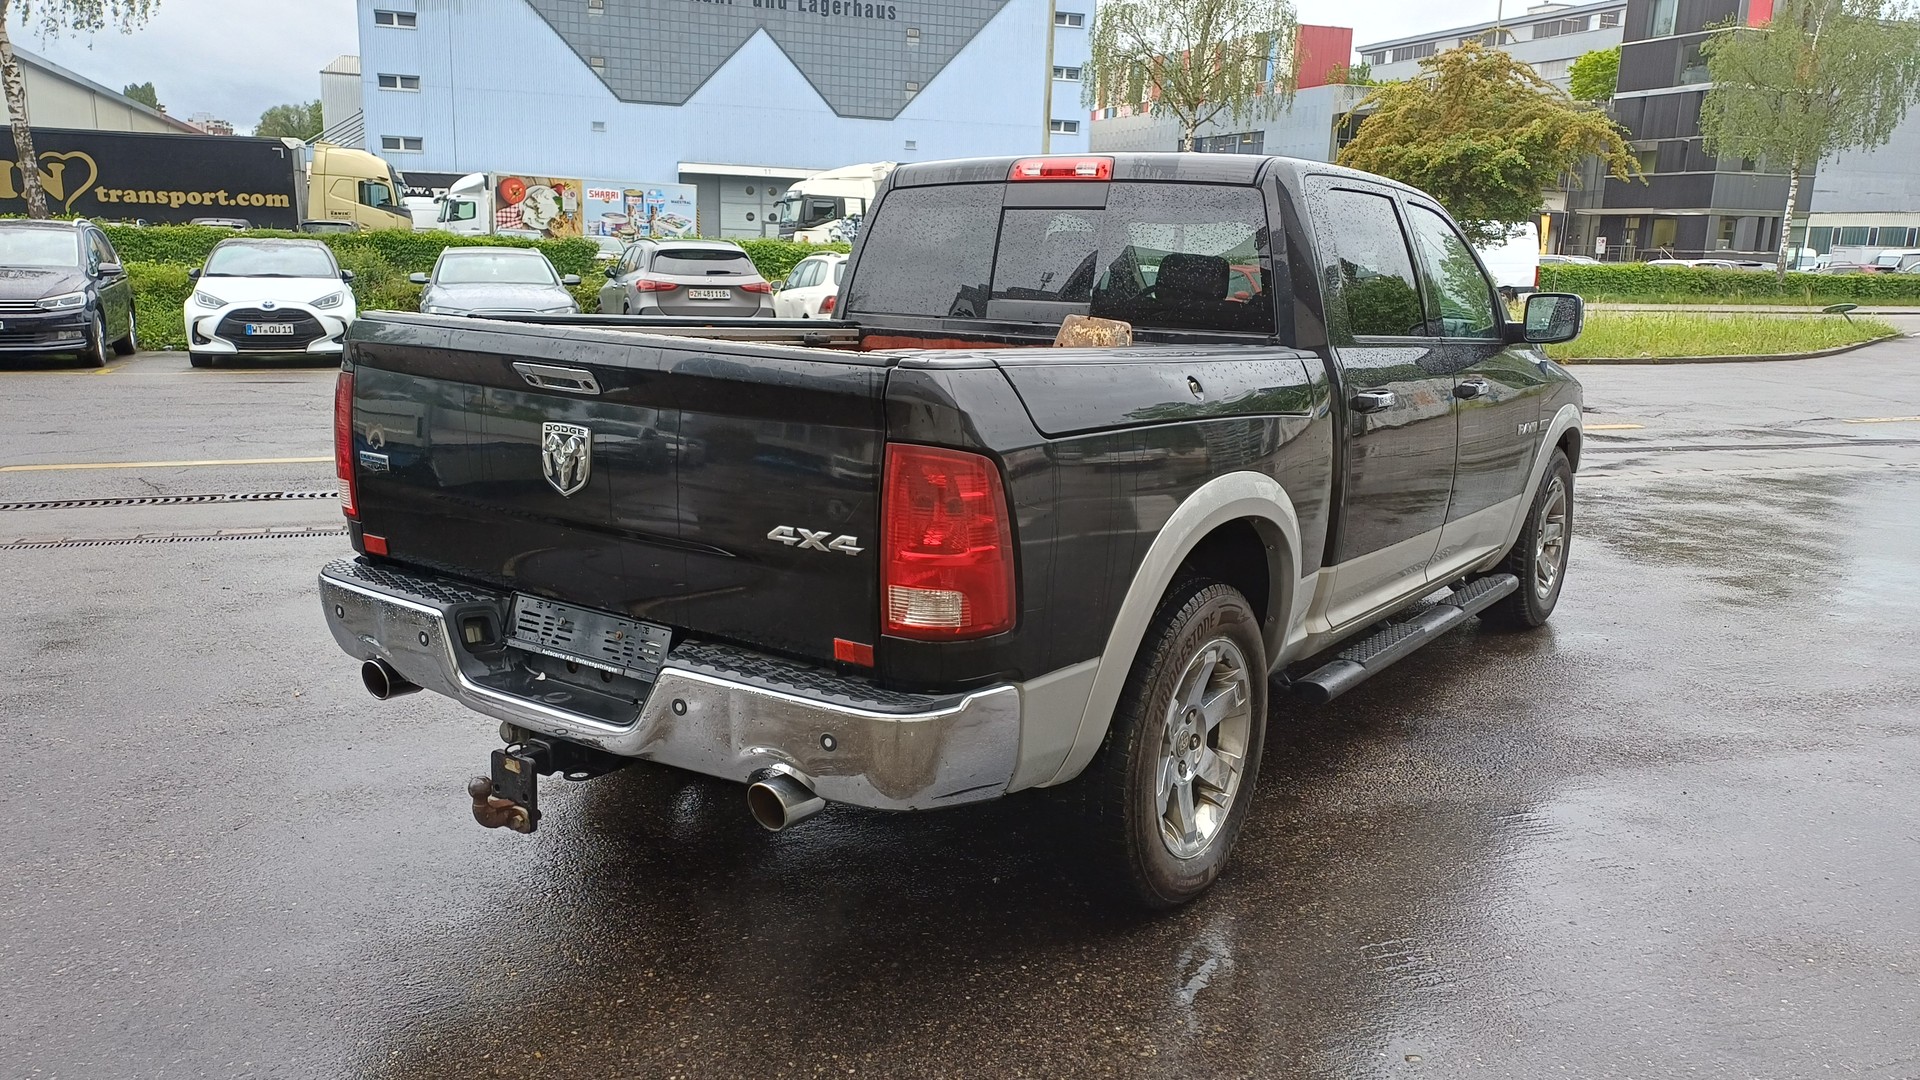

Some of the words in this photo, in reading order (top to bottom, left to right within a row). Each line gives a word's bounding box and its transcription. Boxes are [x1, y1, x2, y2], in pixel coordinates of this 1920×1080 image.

[798, 0, 896, 20] Lagerhaus
[94, 186, 290, 208] transport.com
[545, 424, 585, 436] DODGE
